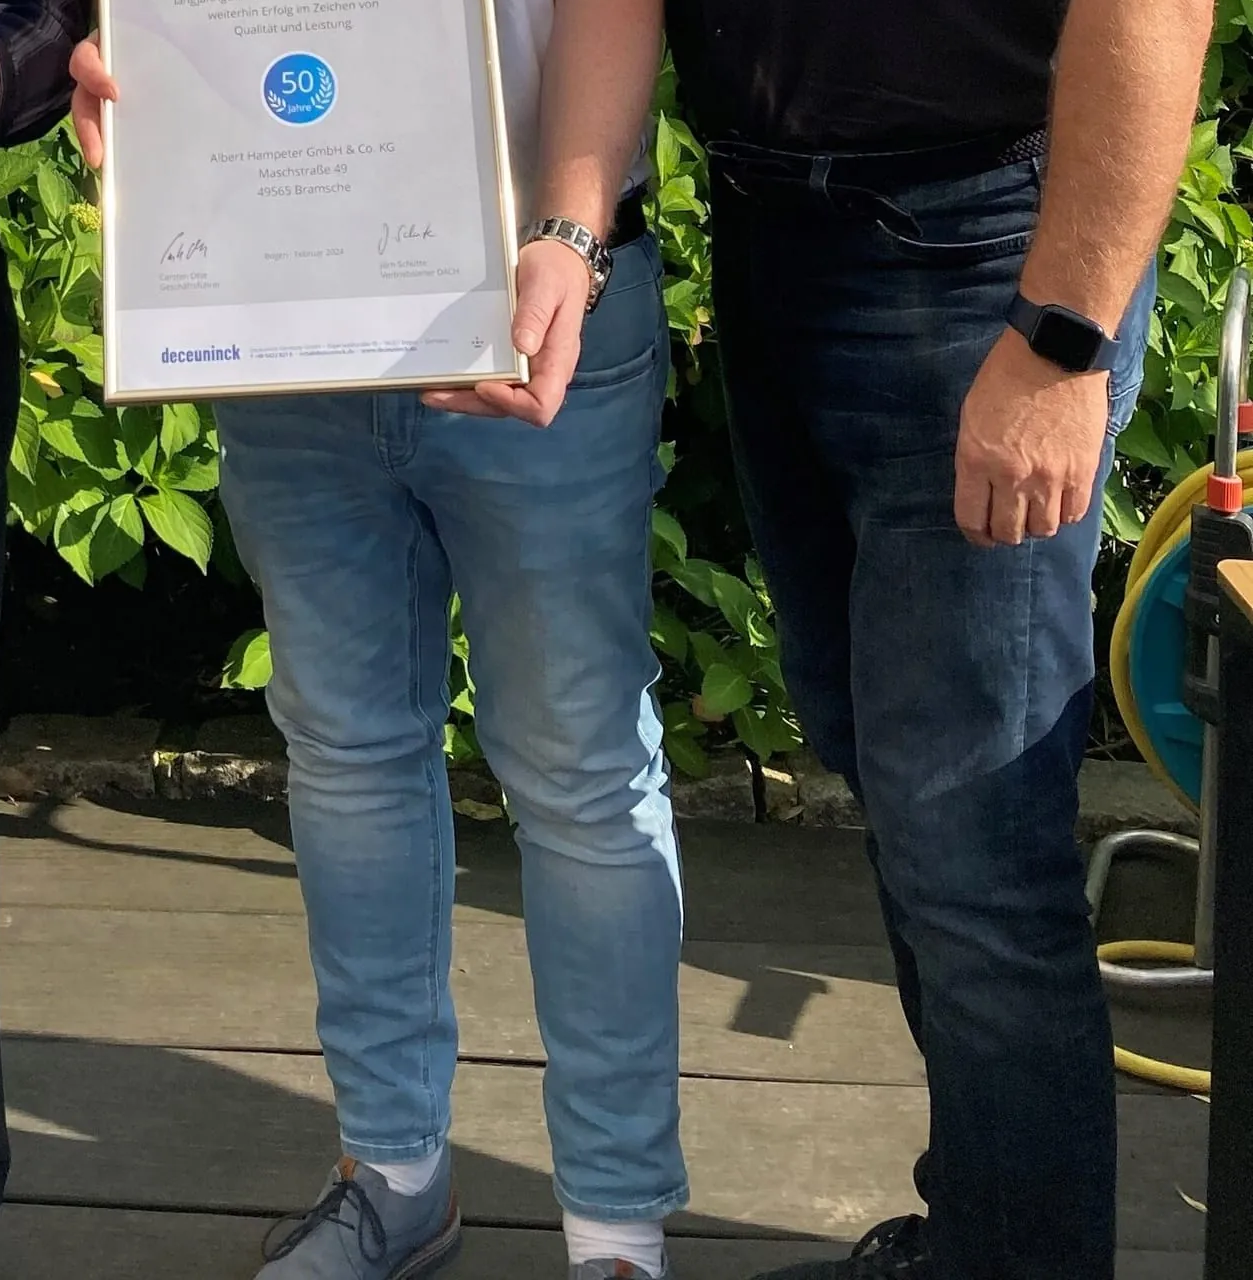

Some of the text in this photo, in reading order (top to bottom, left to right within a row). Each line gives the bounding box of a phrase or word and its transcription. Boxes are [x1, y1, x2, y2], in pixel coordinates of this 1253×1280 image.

[207, 0, 380, 20] weiterhin Erfolg im Zeichen von
[234, 21, 279, 38] Qualität
[280, 20, 303, 32] und
[281, 69, 315, 95] 50
[210, 150, 245, 163] Albert
[247, 146, 304, 161] Hampeter
[306, 144, 343, 157] GmbH
[346, 144, 356, 155] &
[379, 141, 396, 153] KG
[259, 162, 349, 179] Maschstraße 49
[294, 181, 352, 196] Bramsche
[161, 343, 241, 364] deceuninck
